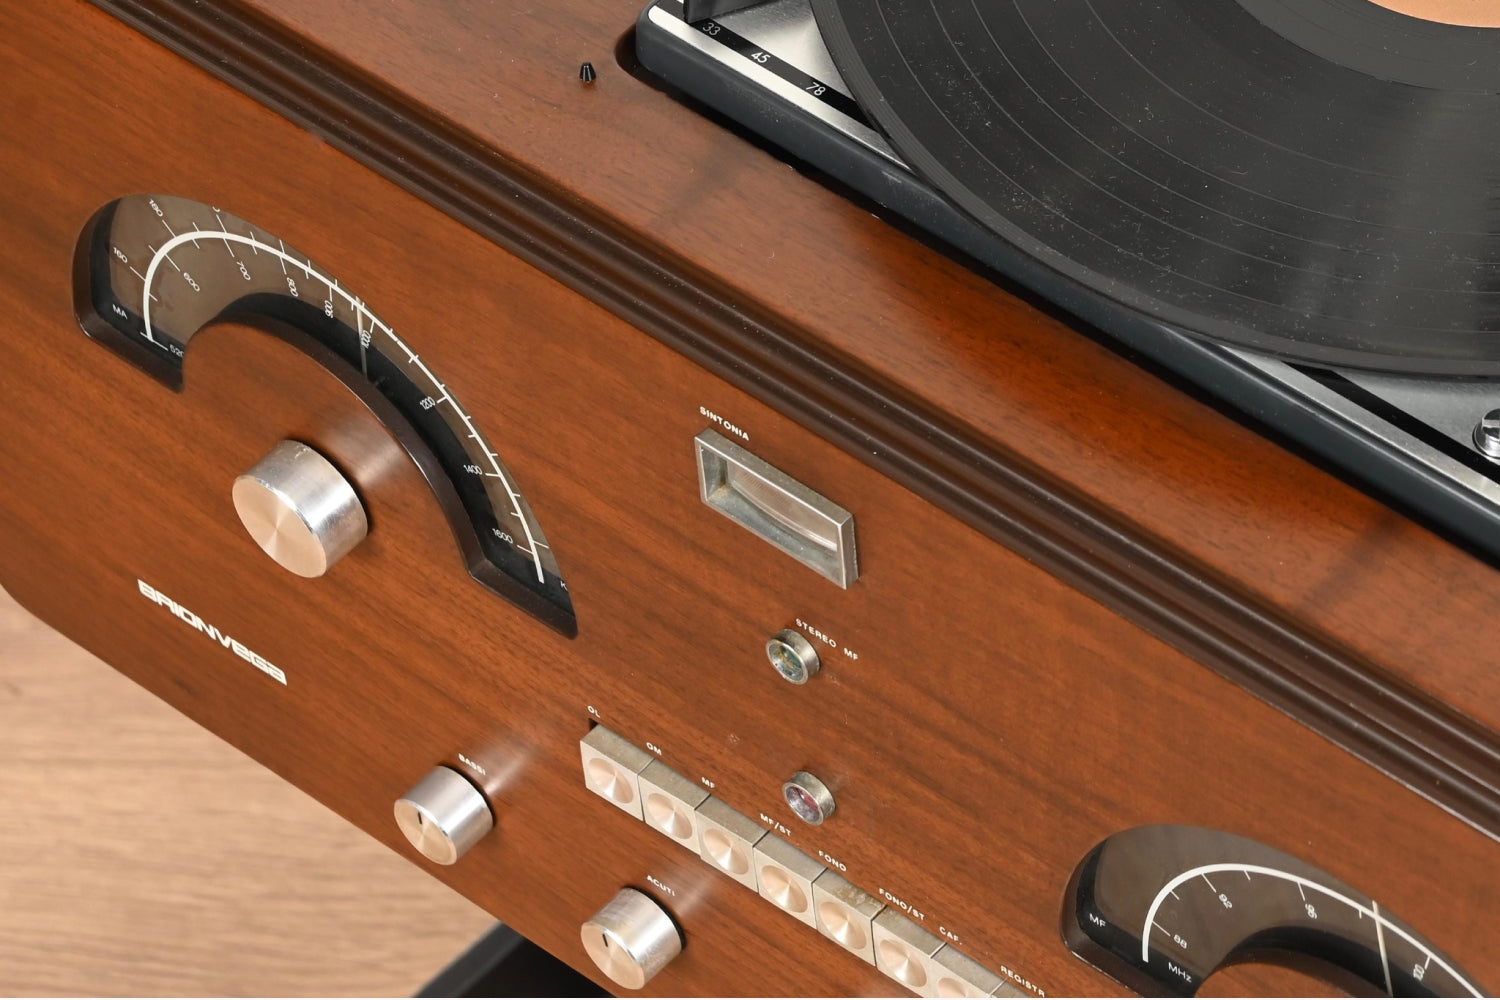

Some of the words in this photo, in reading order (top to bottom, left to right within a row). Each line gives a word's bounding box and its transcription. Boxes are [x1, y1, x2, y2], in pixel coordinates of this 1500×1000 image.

[703, 22, 721, 36] 33
[750, 51, 770, 63] 45
[805, 81, 826, 96] 78
[237, 261, 251, 281] 700
[183, 272, 200, 292] 600
[287, 277, 299, 297] 800
[700, 406, 750, 441] SINTONIA
[463, 464, 483, 475] 1400
[137, 579, 288, 686] BRIONVEGA
[795, 618, 837, 648] STEREO
[843, 648, 859, 660] MF
[587, 705, 601, 718] OL
[646, 742, 662, 755] OM
[458, 753, 486, 775] BASSI
[701, 776, 716, 789] MF
[760, 813, 792, 836] MF/ST
[818, 850, 847, 872] FONO
[646, 875, 676, 896] ACUTI
[878, 888, 926, 921] FONO/ST
[1218, 893, 1233, 909] 92
[1089, 913, 1106, 928] MF
[1173, 934, 1188, 949] 88
[1000, 965, 1046, 998] REGISTR
[1168, 962, 1192, 983] MHz
